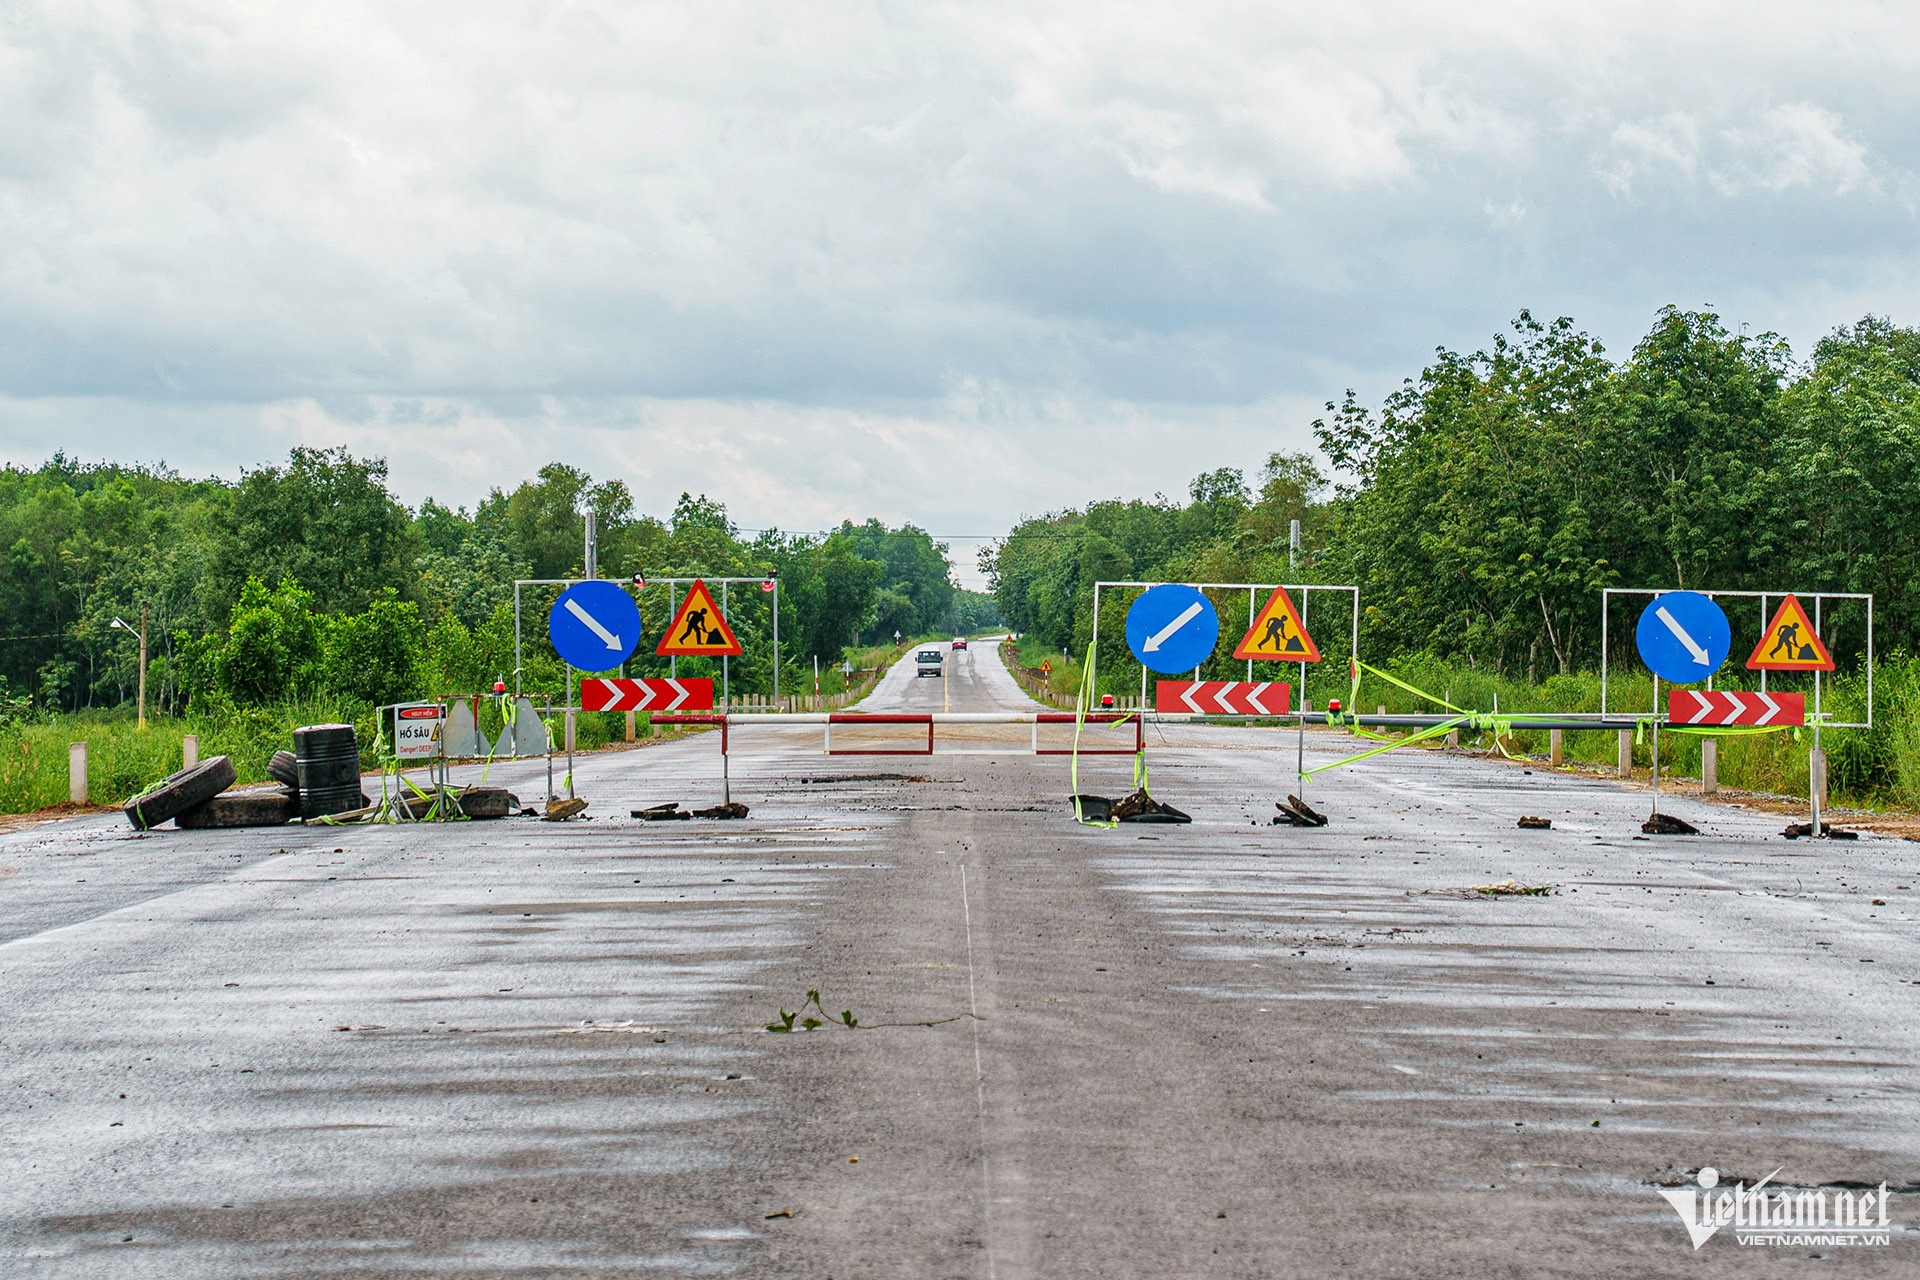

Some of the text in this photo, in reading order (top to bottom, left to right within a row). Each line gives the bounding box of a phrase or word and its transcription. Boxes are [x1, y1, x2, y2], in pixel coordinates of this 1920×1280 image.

[400, 725, 429, 739] HỐ SÂU
[400, 746, 418, 754] Danger!
